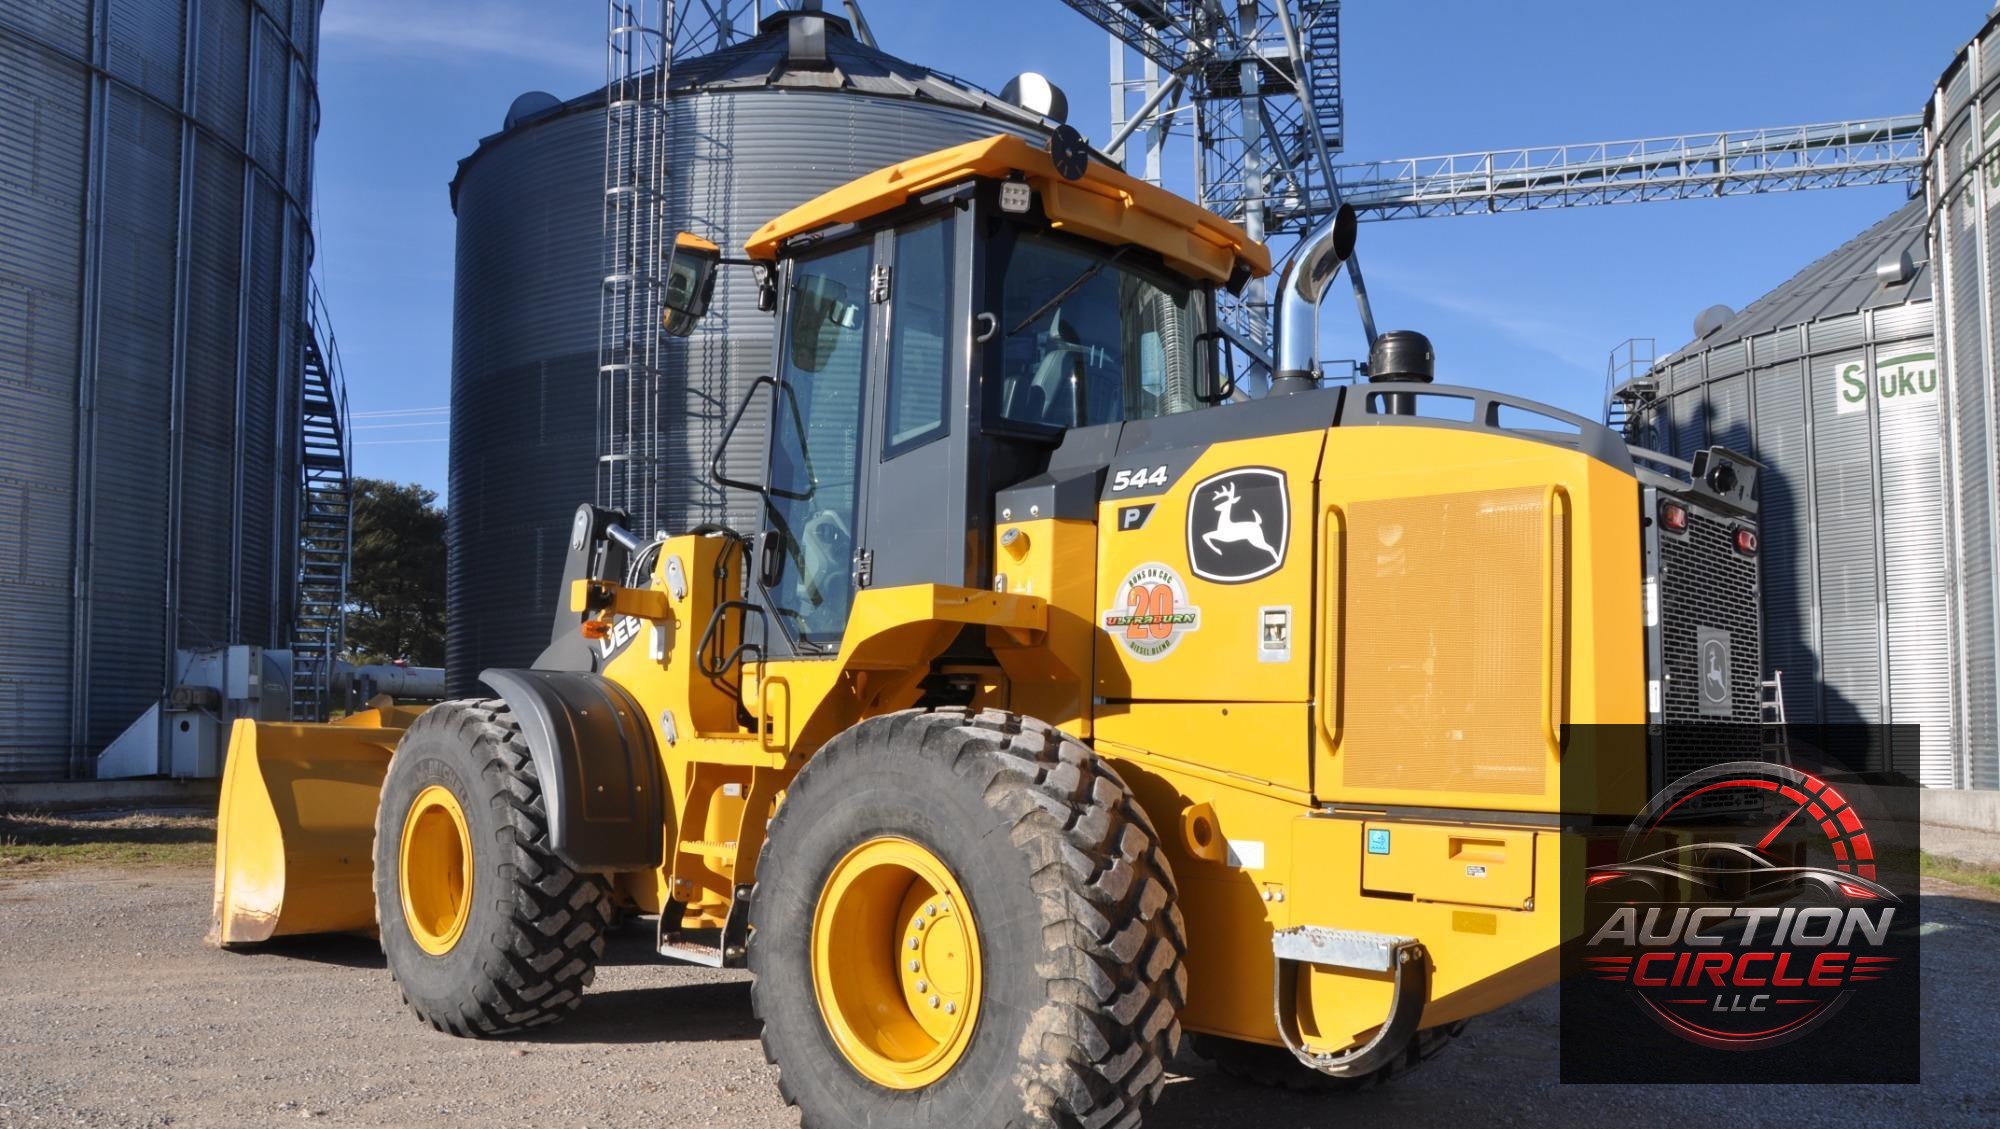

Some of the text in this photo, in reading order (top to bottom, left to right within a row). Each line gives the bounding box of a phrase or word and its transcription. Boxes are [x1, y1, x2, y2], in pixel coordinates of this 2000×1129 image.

[1112, 465, 1168, 492] 544
[1123, 508, 1141, 529] P
[1106, 613, 1196, 627] ULTRABURN
[1126, 583, 1174, 640] 20
[599, 615, 642, 660] DEE
